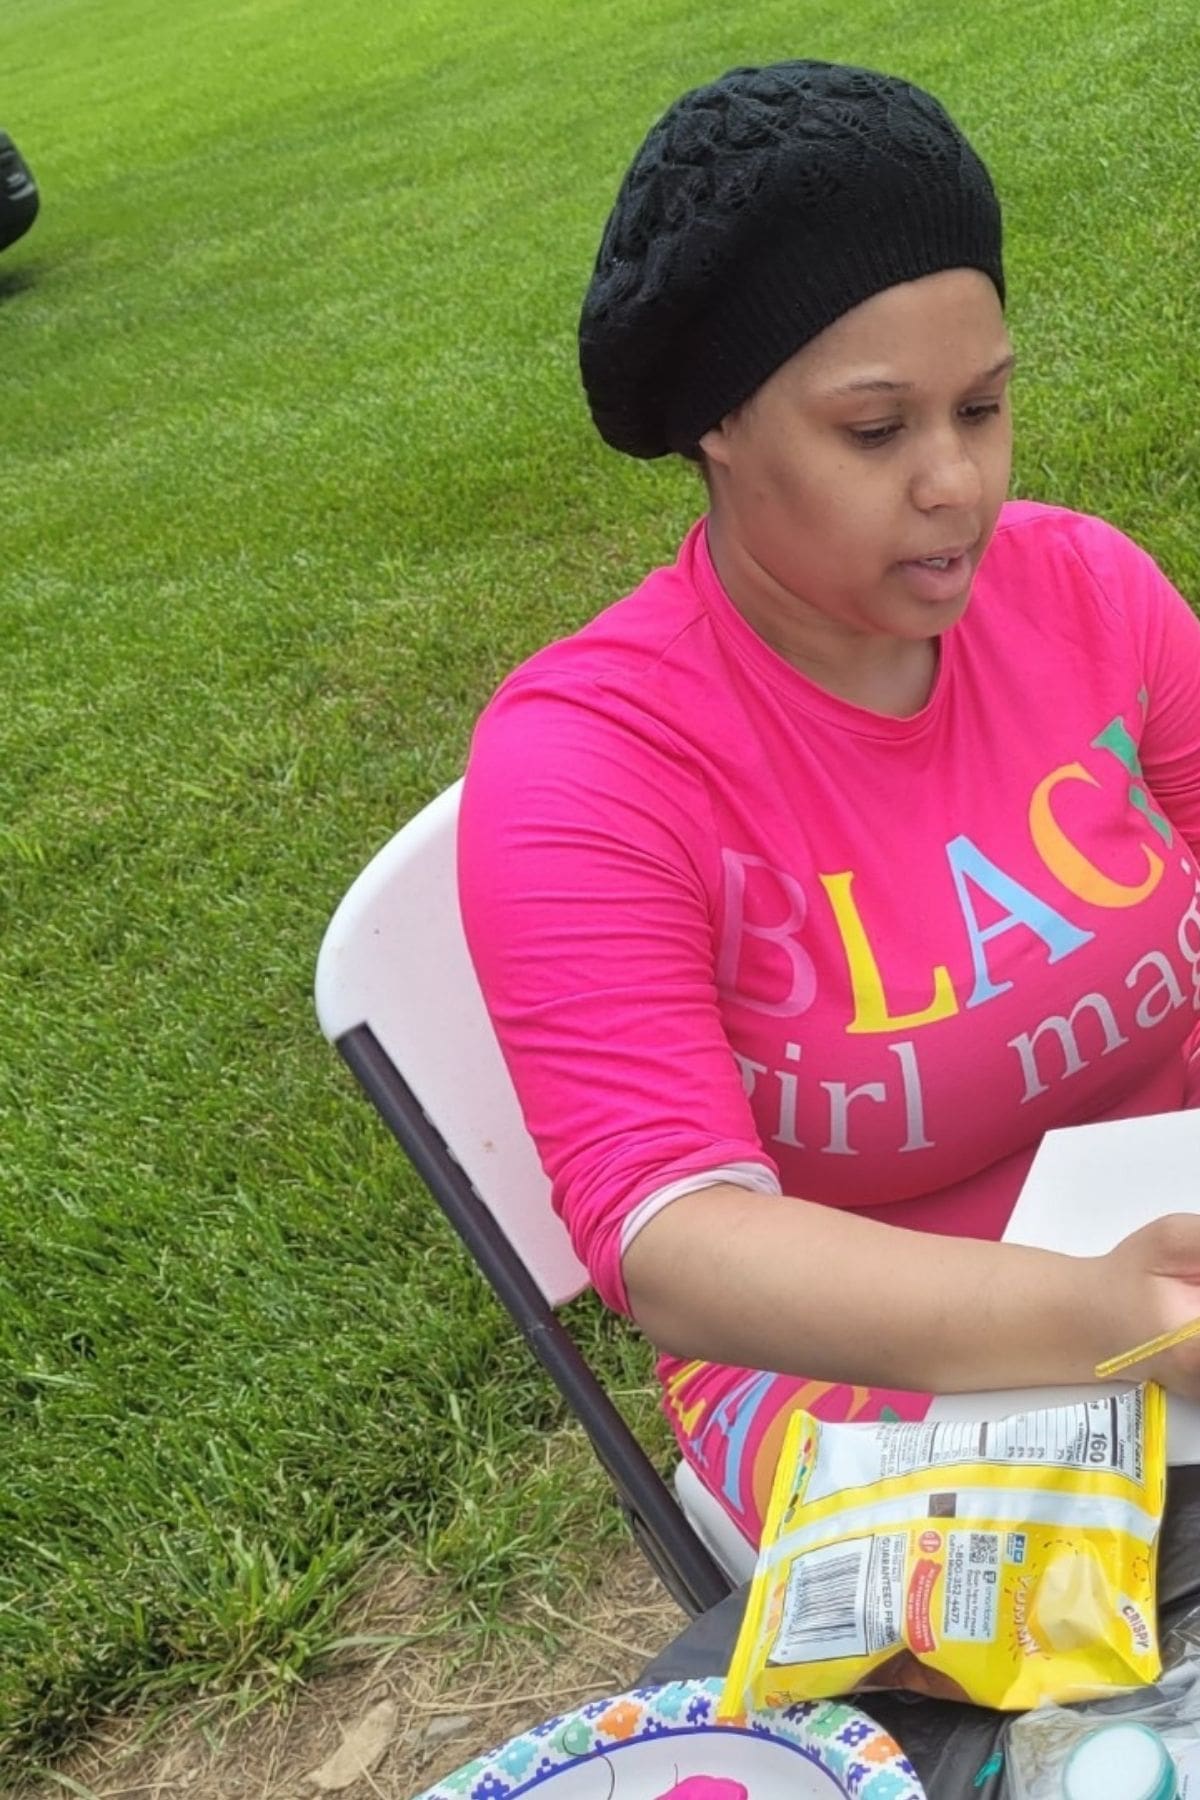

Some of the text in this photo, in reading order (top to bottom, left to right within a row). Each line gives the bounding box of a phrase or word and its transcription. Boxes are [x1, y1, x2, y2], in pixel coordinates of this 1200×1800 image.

[1089, 1432, 1108, 1463] 160
[880, 1537, 893, 1608] GUARANTEED
[1121, 1604, 1150, 1649] CRISPY
